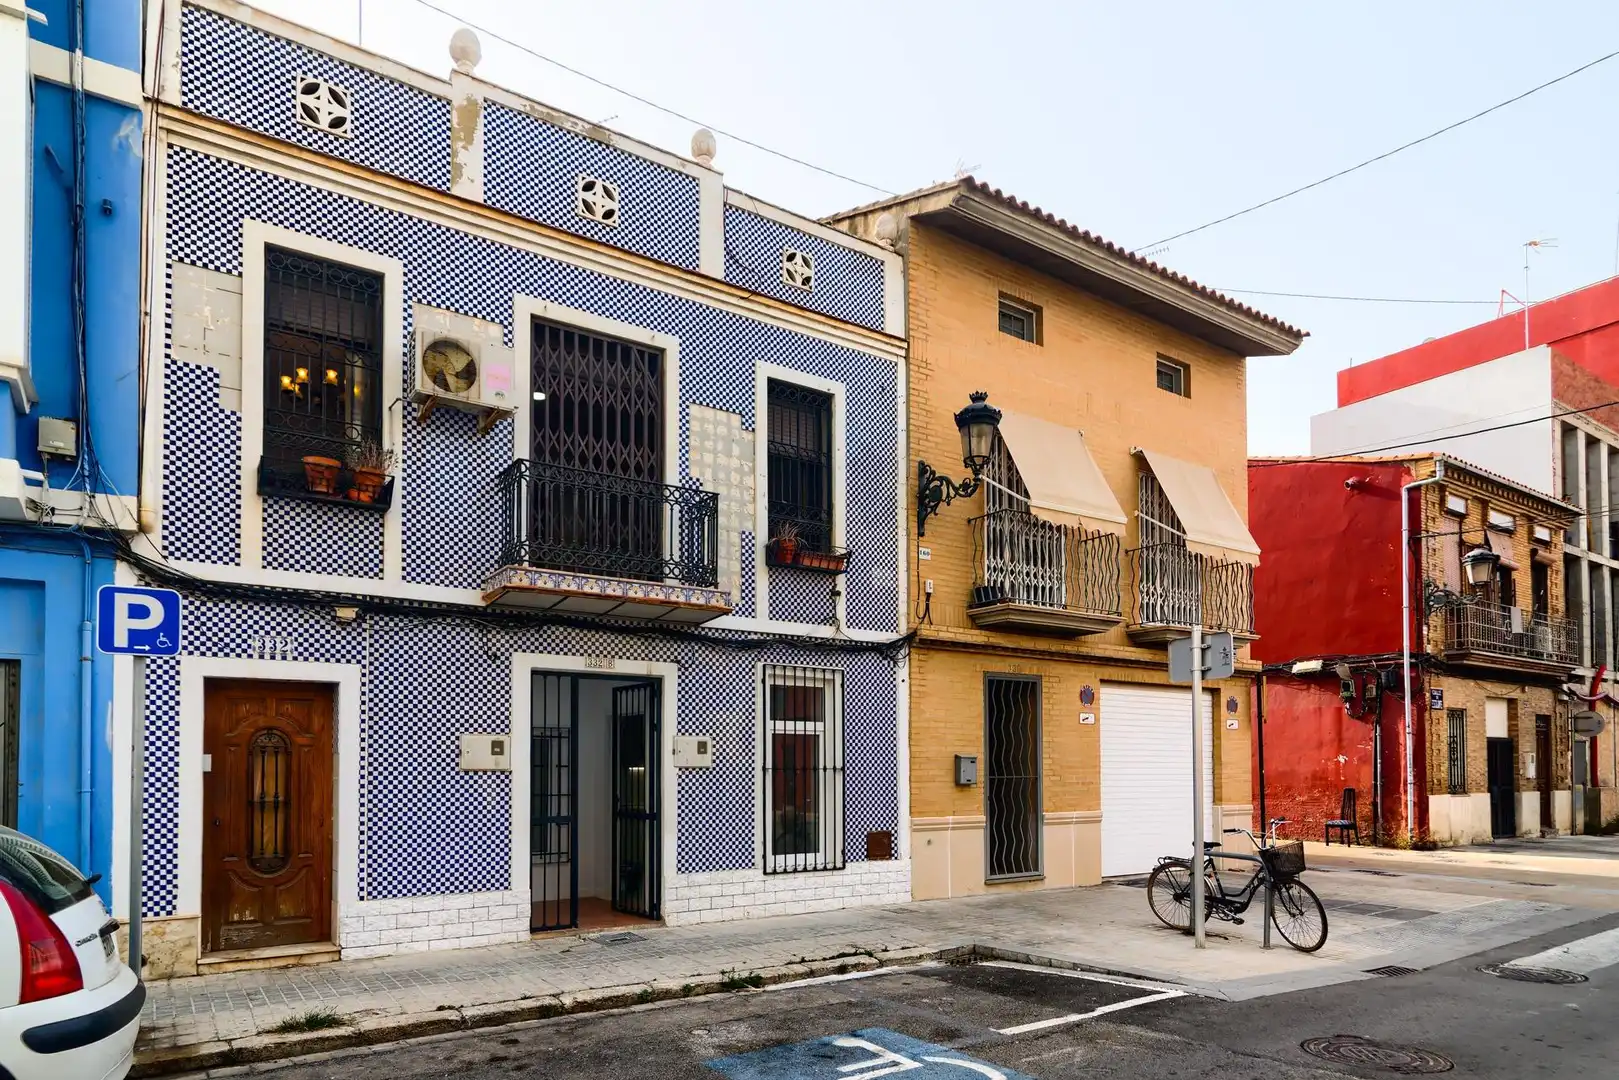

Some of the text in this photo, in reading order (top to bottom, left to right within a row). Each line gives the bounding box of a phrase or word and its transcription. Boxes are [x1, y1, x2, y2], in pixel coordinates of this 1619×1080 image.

[114, 592, 165, 648] P
[258, 638, 289, 653] 332
[588, 659, 603, 668] 332
